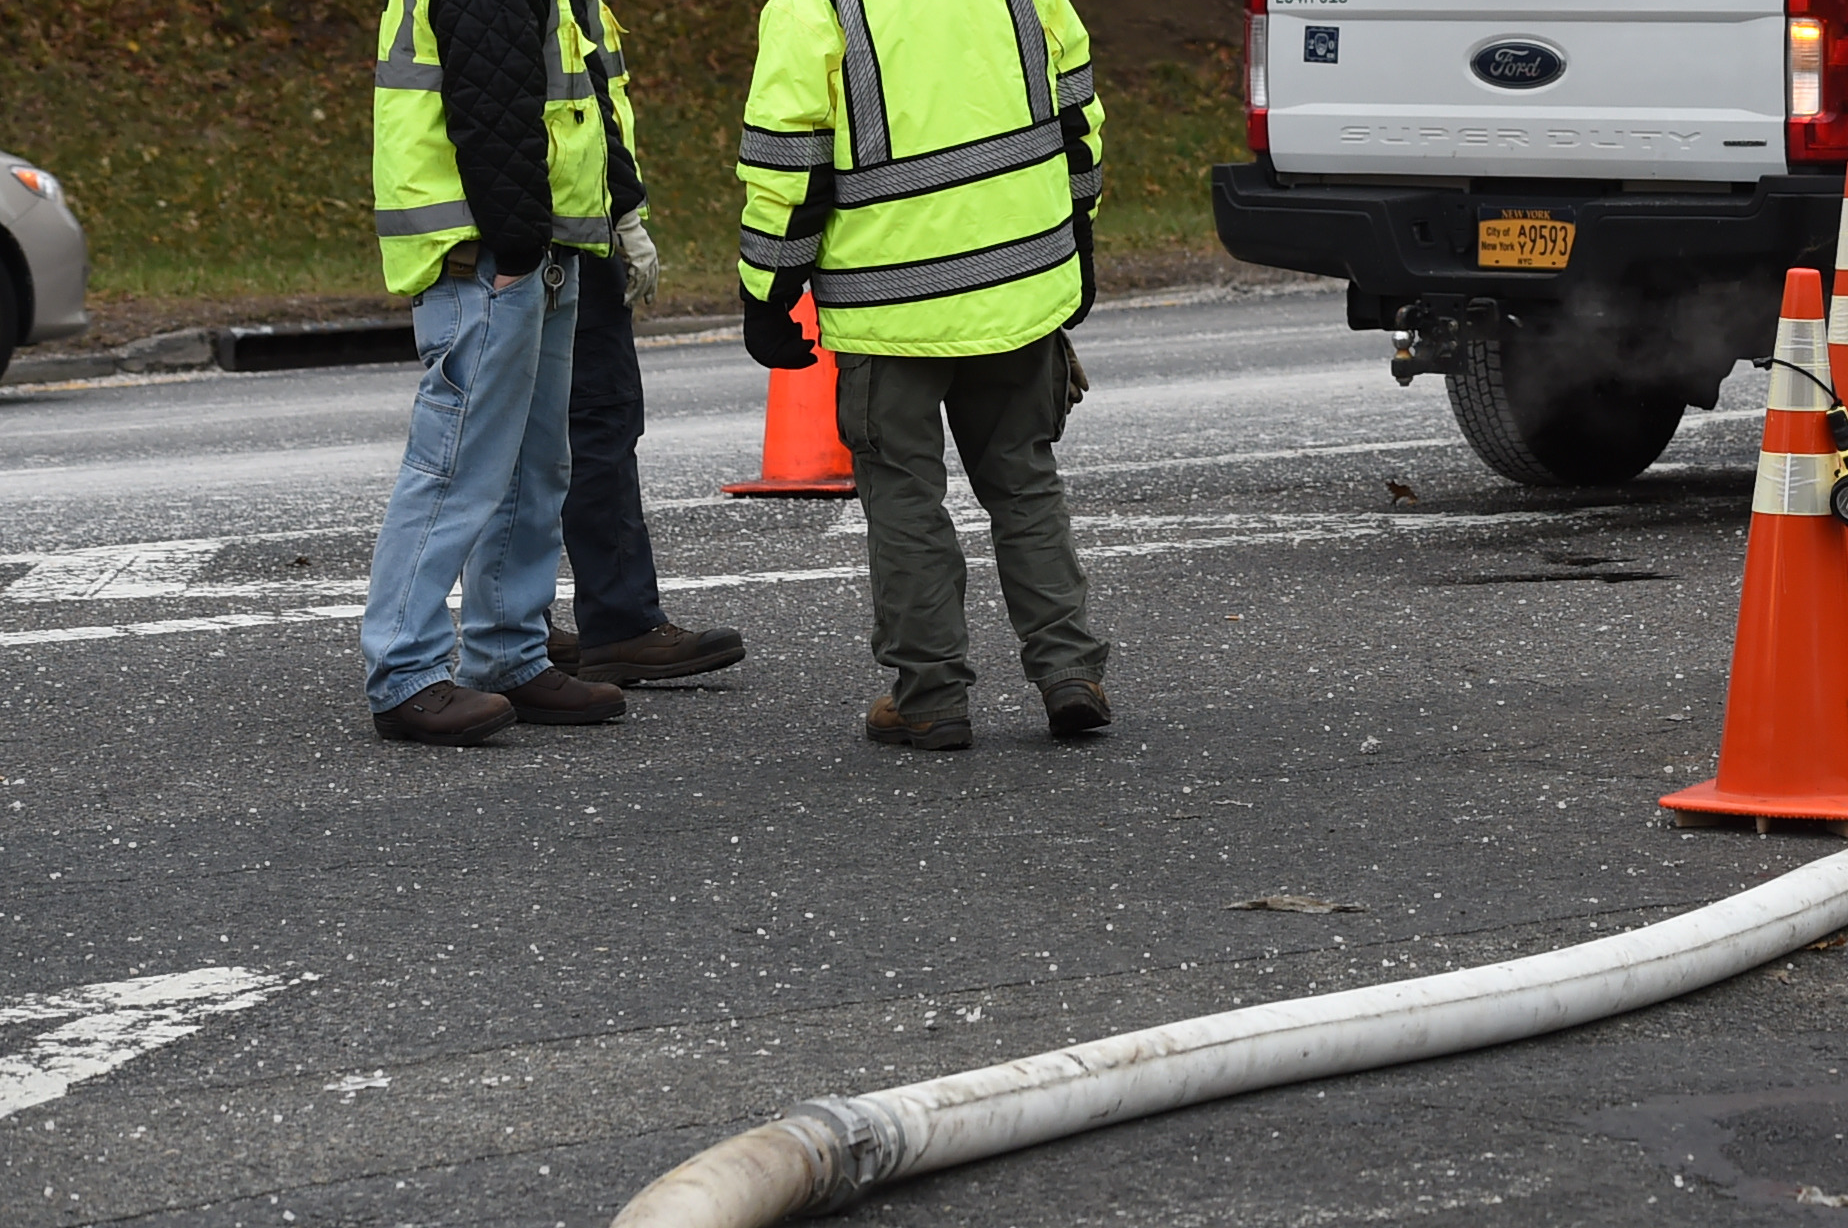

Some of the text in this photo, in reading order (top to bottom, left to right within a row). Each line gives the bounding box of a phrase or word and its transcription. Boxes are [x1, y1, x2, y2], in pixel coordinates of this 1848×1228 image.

[1490, 48, 1541, 77] Ford
[1340, 126, 1701, 151] SUPER DUTY
[1502, 209, 1551, 220] NEW YORK
[1486, 227, 1500, 238] City
[1502, 227, 1510, 237] of
[1481, 241, 1497, 251] New
[1499, 241, 1515, 251] York
